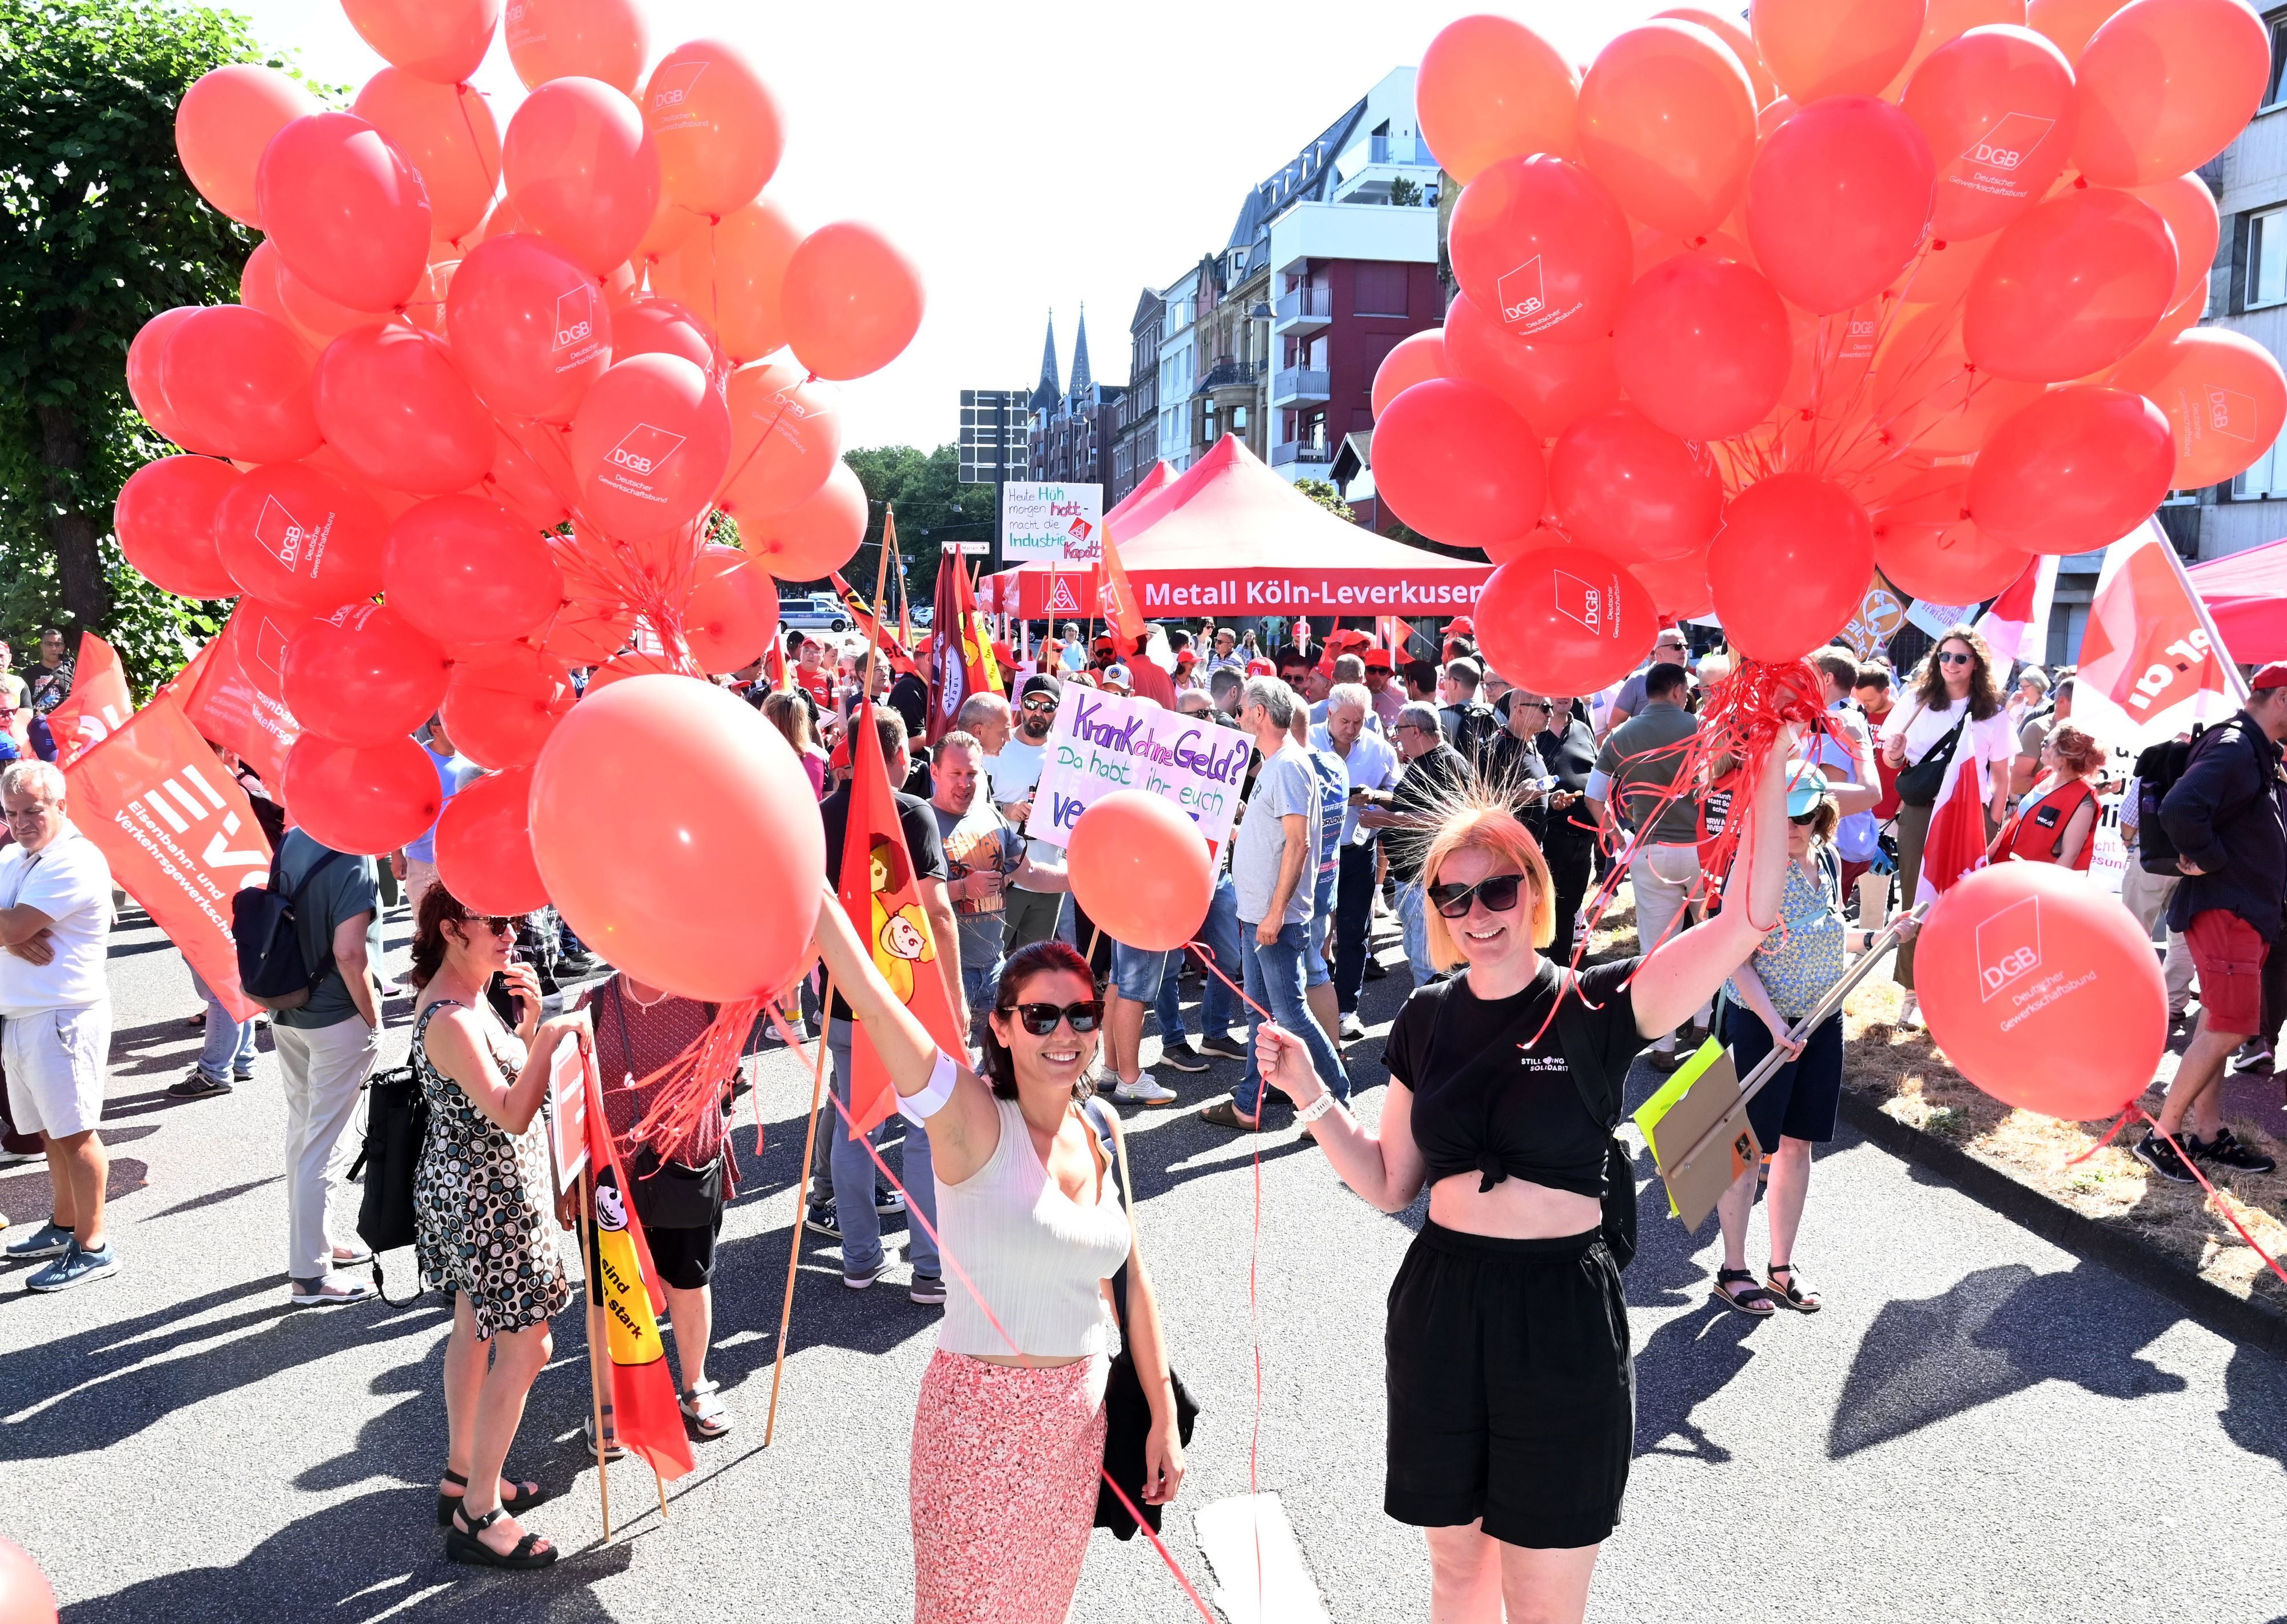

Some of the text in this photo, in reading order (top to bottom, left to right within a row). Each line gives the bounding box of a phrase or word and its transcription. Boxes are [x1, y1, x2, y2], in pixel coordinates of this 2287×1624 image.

[656, 89, 683, 107] DGB
[661, 112, 691, 122] Deutscher
[1975, 144, 2019, 167] DGB
[1949, 175, 2028, 197] Gewerkschaftsbund
[1974, 172, 2017, 187] Deutscher
[1505, 297, 1541, 319] DGB
[1519, 302, 1583, 336] Gewerkschaftsbund
[1525, 309, 1561, 328] Deutscher
[558, 321, 589, 345] DGB
[571, 342, 599, 360] Deutscher
[774, 393, 805, 418] DGB
[2209, 391, 2228, 429] DGB
[614, 448, 652, 472] DGB
[598, 475, 668, 503] Gewerkschaftsbund
[615, 474, 653, 492] Deutscher
[1009, 486, 1064, 501] Heute Hüh
[1009, 505, 1046, 517] morgen
[1010, 520, 1059, 529] macht die
[280, 526, 301, 561] DGB
[305, 525, 321, 561] Deutscher
[310, 512, 335, 578] Gewerkschaftsbund
[1010, 533, 1066, 548] Industrie
[1145, 581, 1236, 606] Metall
[1612, 574, 1620, 638] Gewerkschaftsbund
[1585, 590, 1599, 624] DGB
[1133, 728, 1174, 767] ohne
[1174, 729, 1249, 785] Geld?
[1057, 746, 1083, 769] Da
[1089, 749, 1131, 785] habt
[1146, 768, 1172, 796] ihr
[1179, 787, 1224, 816] euch
[2037, 815, 2054, 827] ver.di
[127, 800, 197, 872] Eisenbahn-
[196, 872, 226, 900] und
[114, 809, 238, 951] Verkehrsgewerkscha
[1983, 947, 2037, 989] DGB
[2000, 970, 2097, 1032] Gewerkschaftsbund
[2012, 971, 2065, 1006] Deutscher
[601, 1258, 629, 1294] sind
[608, 1298, 643, 1341] stark
